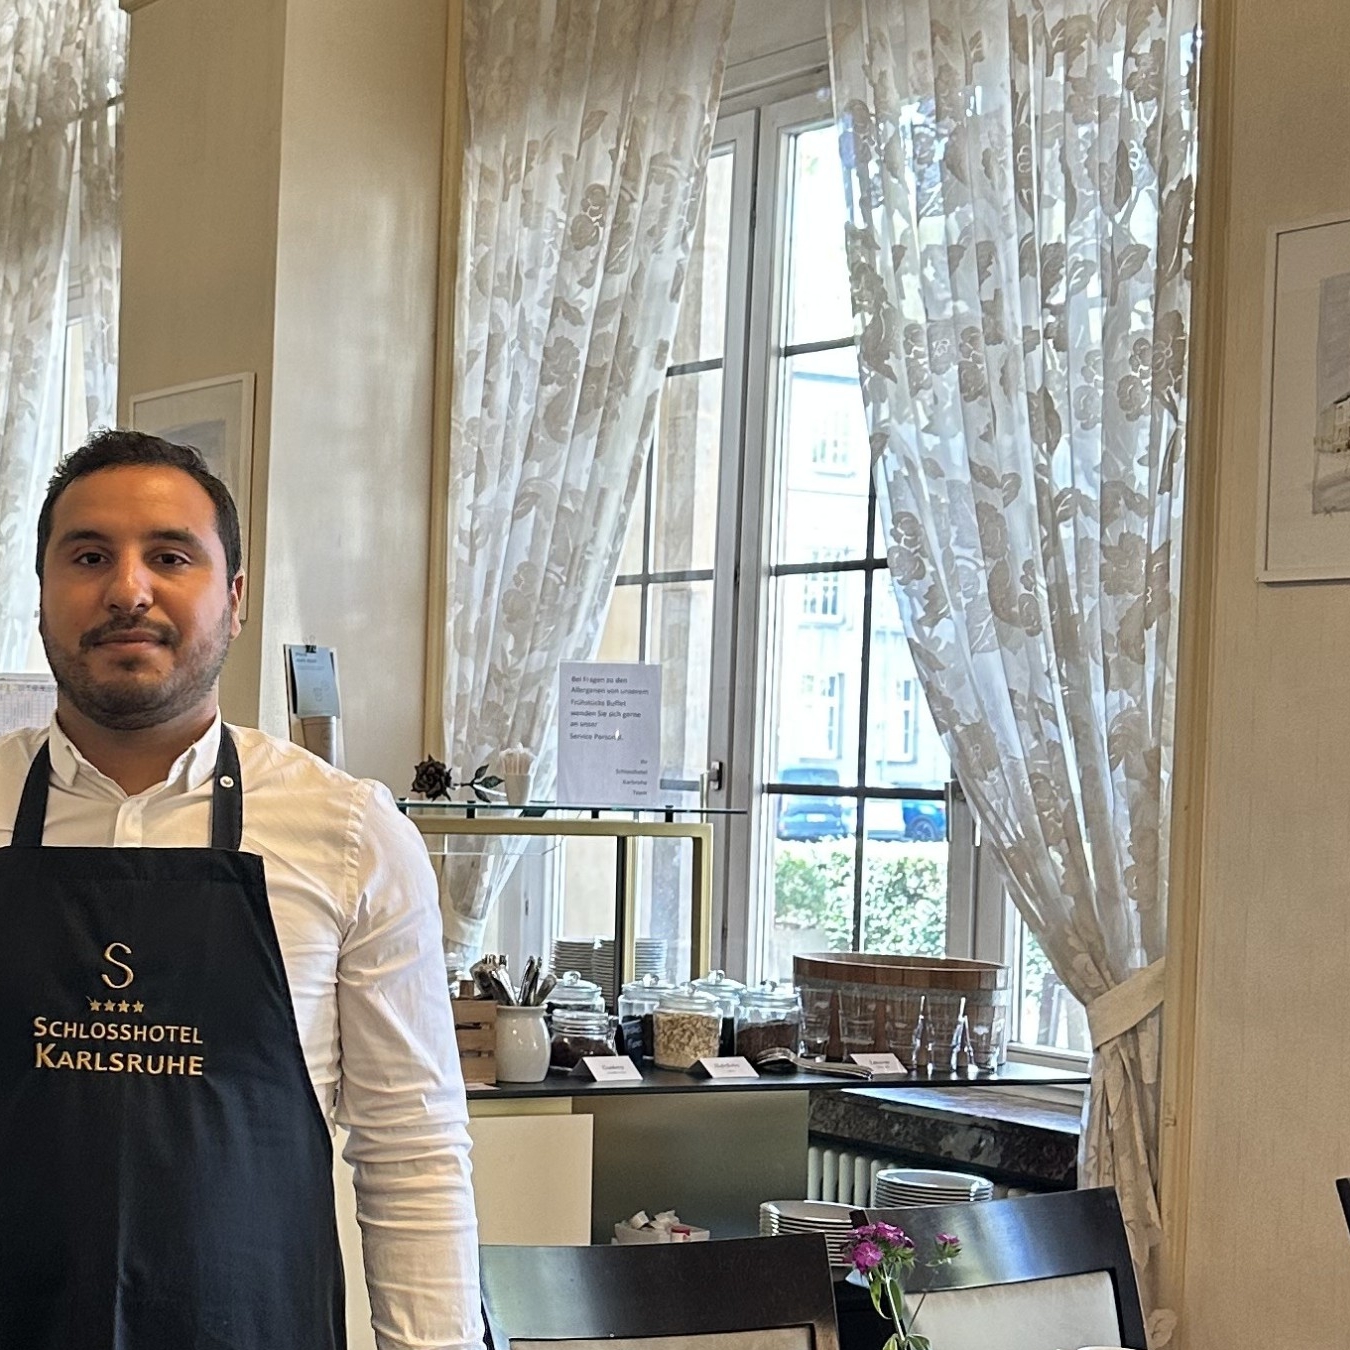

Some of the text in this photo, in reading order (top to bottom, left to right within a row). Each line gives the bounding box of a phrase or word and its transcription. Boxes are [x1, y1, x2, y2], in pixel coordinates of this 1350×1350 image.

[102, 942, 134, 989] S
[33, 1016, 204, 1044] SCHLOSSHOTEL
[34, 1042, 204, 1076] KARLSRUHE
